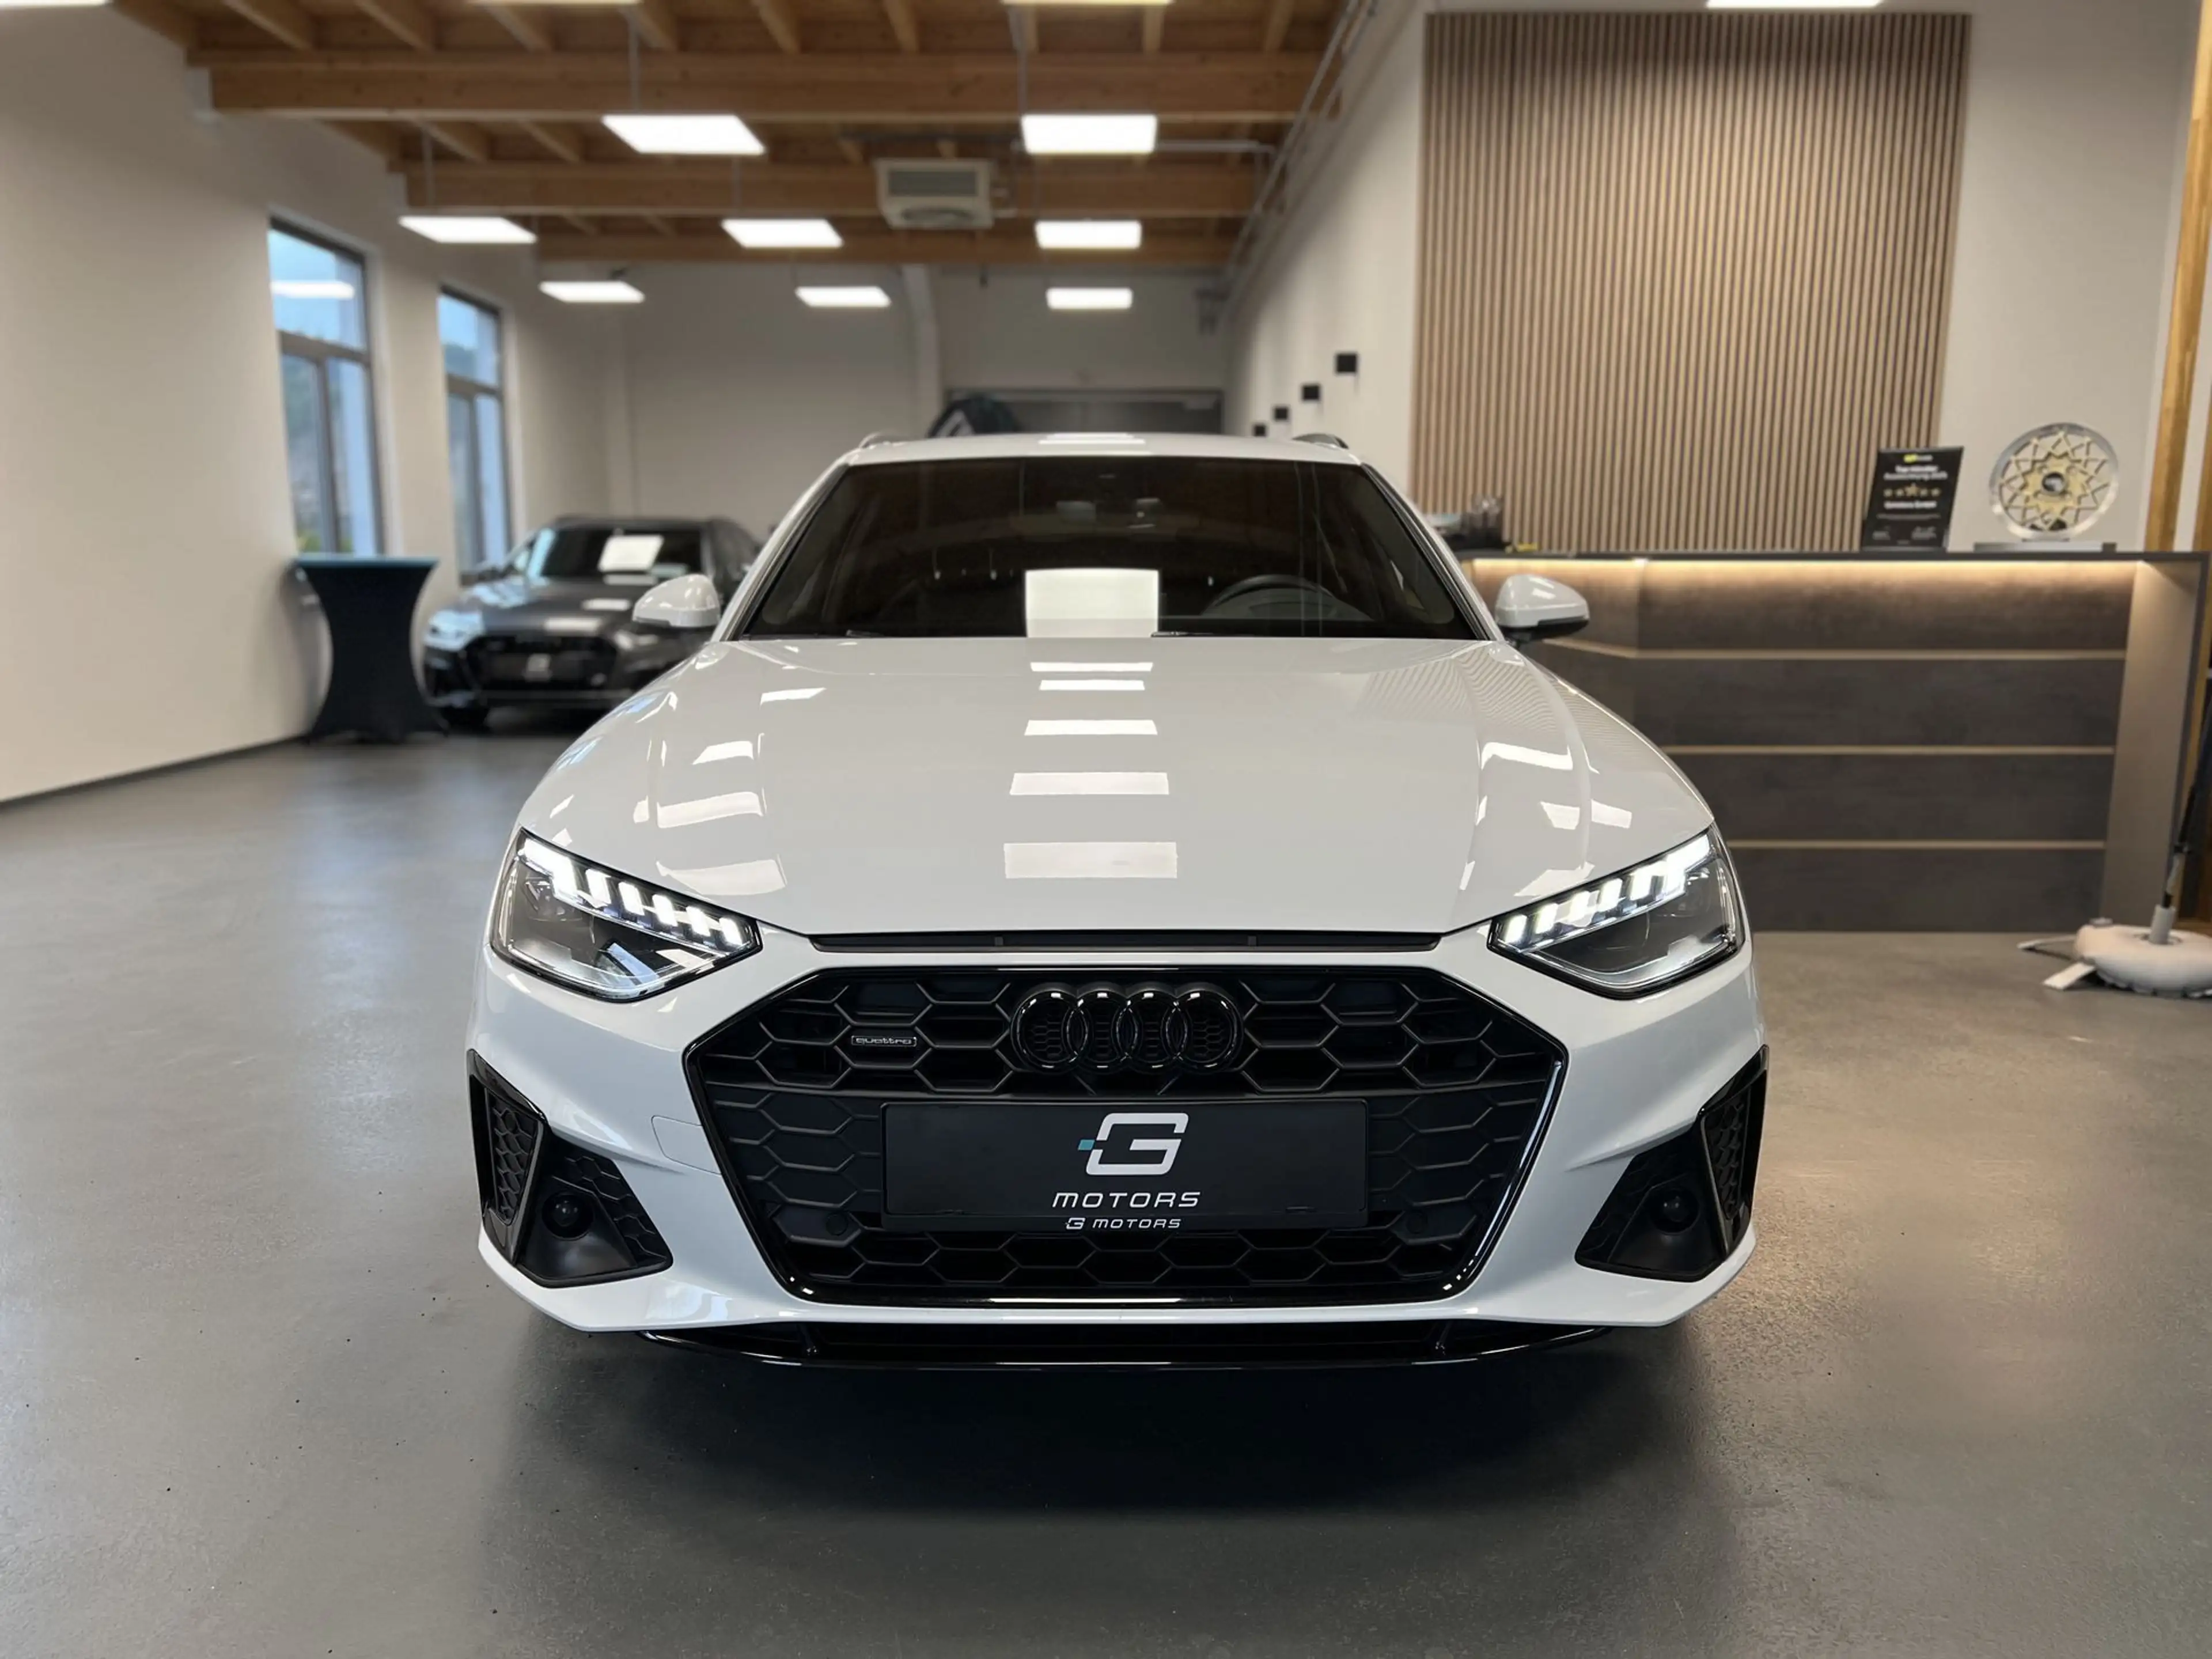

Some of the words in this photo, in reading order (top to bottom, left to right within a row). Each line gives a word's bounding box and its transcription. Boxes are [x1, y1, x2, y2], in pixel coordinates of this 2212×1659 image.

[855, 1037, 912, 1046] quattro
[1082, 1112, 1189, 1175] G
[1052, 1192, 1200, 1208] MOTORS
[1066, 1217, 1086, 1230] G
[1092, 1218, 1181, 1229] MOTORS
